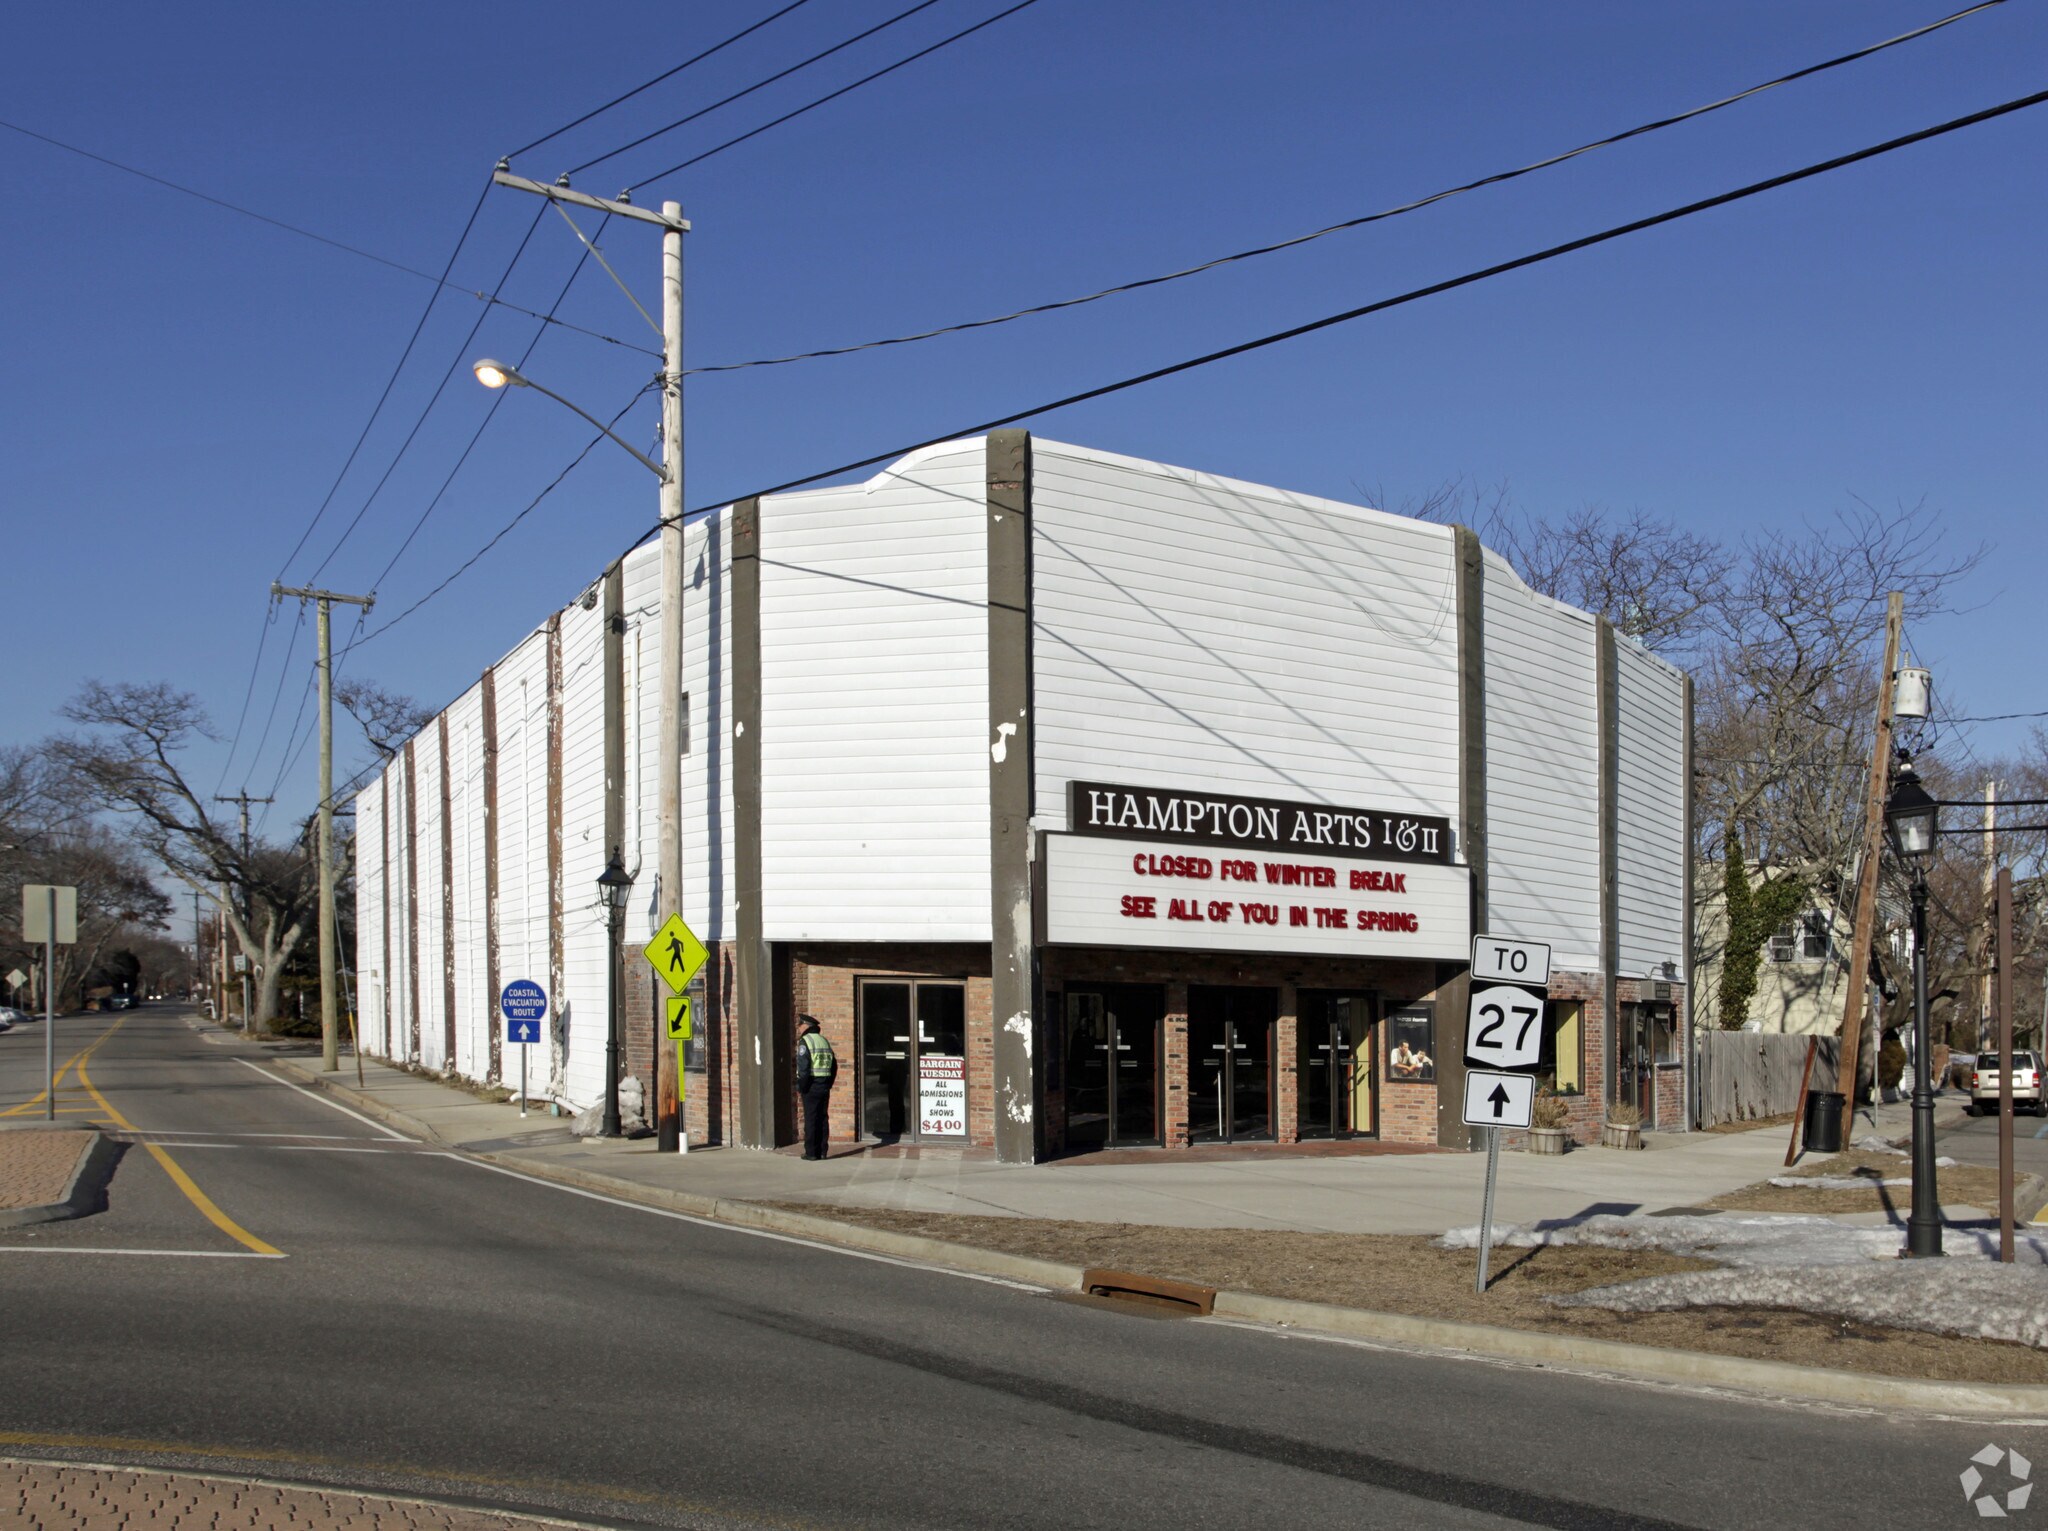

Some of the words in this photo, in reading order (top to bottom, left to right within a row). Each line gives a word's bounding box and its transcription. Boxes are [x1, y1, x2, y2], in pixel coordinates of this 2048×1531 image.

[1088, 790, 1280, 841] HAMPTON
[1290, 810, 1371, 848] ARTS
[1133, 853, 1213, 880] CLOSED
[1221, 859, 1258, 883] FOR
[1264, 862, 1336, 888] WINTER
[1350, 869, 1407, 894] BREAK
[1120, 895, 1157, 919] SEE
[1167, 898, 1204, 921] ALL
[1208, 900, 1233, 923] OF
[1239, 902, 1279, 926] YOU
[1289, 906, 1308, 928] IN
[1314, 907, 1348, 930] THE
[1357, 910, 1419, 933] SPRING
[1494, 947, 1528, 973] TO
[504, 998, 544, 1006] EVACUATION
[1475, 1003, 1539, 1051] 27
[920, 1060, 962, 1068] BARGAIN
[920, 1069, 963, 1078] TUESDAY
[920, 1090, 963, 1098] ADMISSIONS
[935, 1099, 947, 1107] ALL
[929, 1109, 954, 1117] SHOWS
